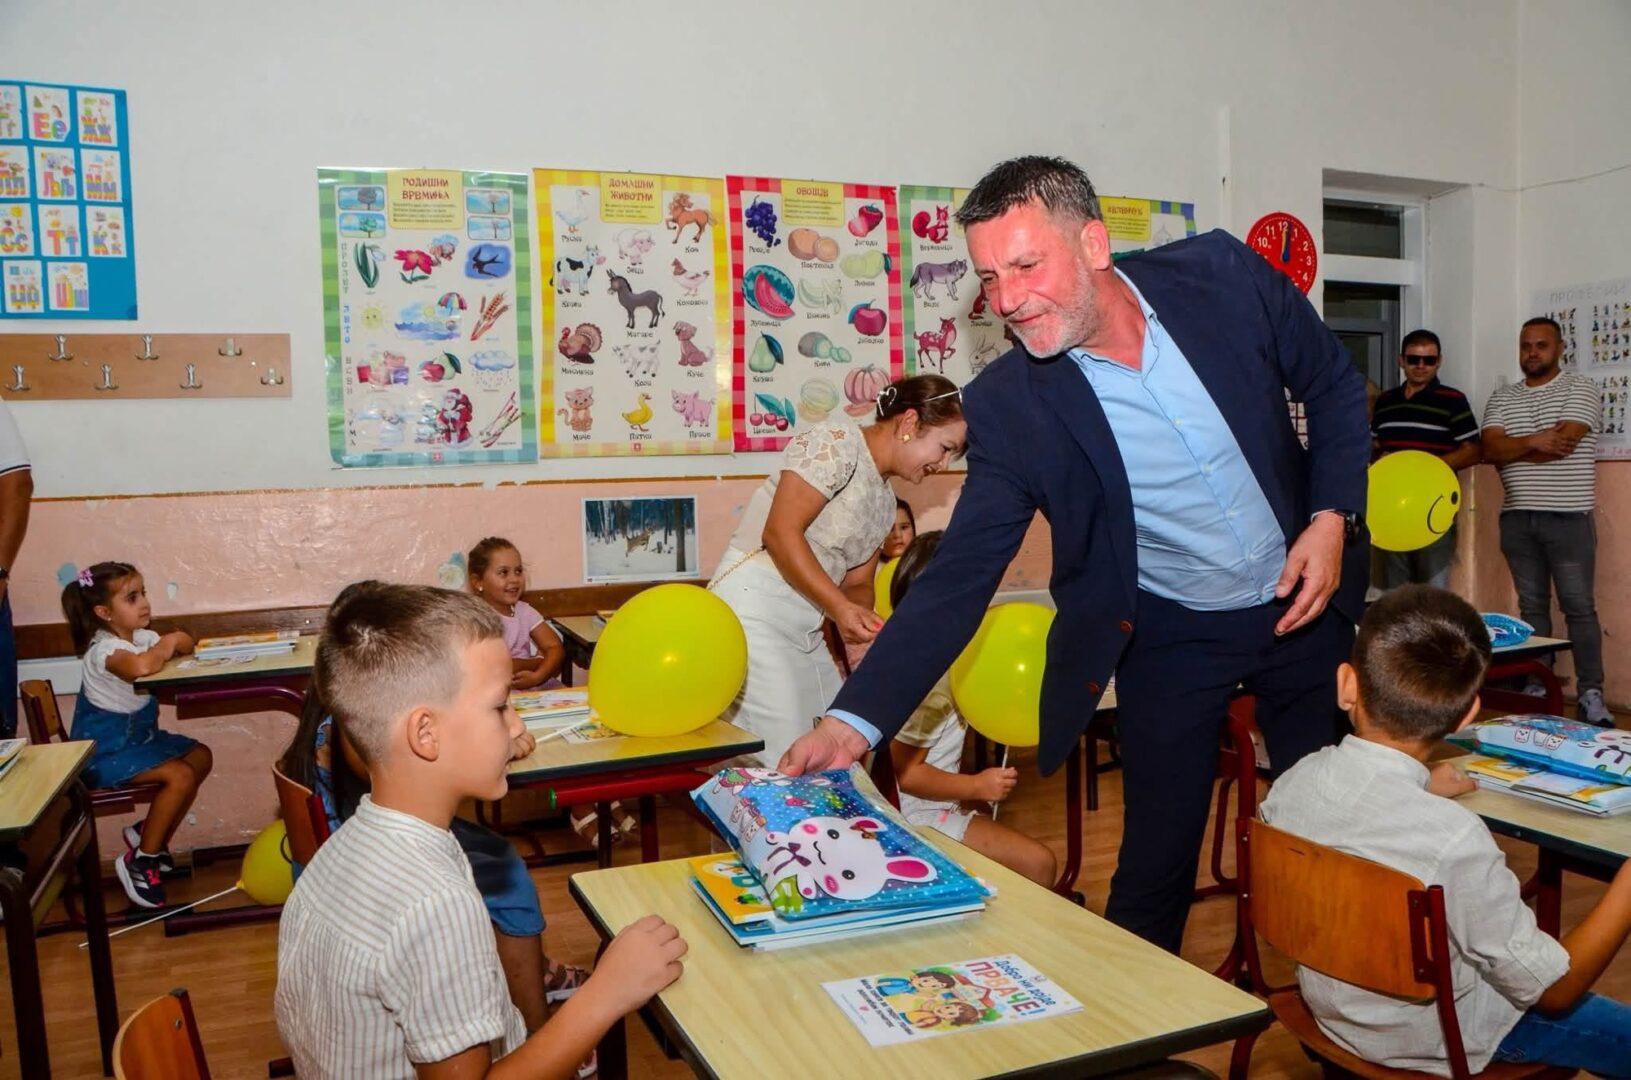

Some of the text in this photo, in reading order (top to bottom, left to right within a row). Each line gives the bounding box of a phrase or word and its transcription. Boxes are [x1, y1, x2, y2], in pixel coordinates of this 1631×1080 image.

[608, 178, 654, 188] ДОМАШНИ
[610, 191, 653, 201] ЖИВОТНИ
[1265, 225, 1275, 237] 11
[1278, 221, 1288, 231] 12
[1294, 228, 1298, 238] 1
[1257, 236, 1268, 248] 10
[1303, 241, 1309, 251] 2
[1306, 255, 1312, 266] 3
[1302, 272, 1308, 282] 4
[687, 370, 704, 378] Куче
[994, 960, 1023, 980] Добро
[1018, 979, 1034, 988] ни
[965, 961, 1046, 1016] ПРВАЧЕ!
